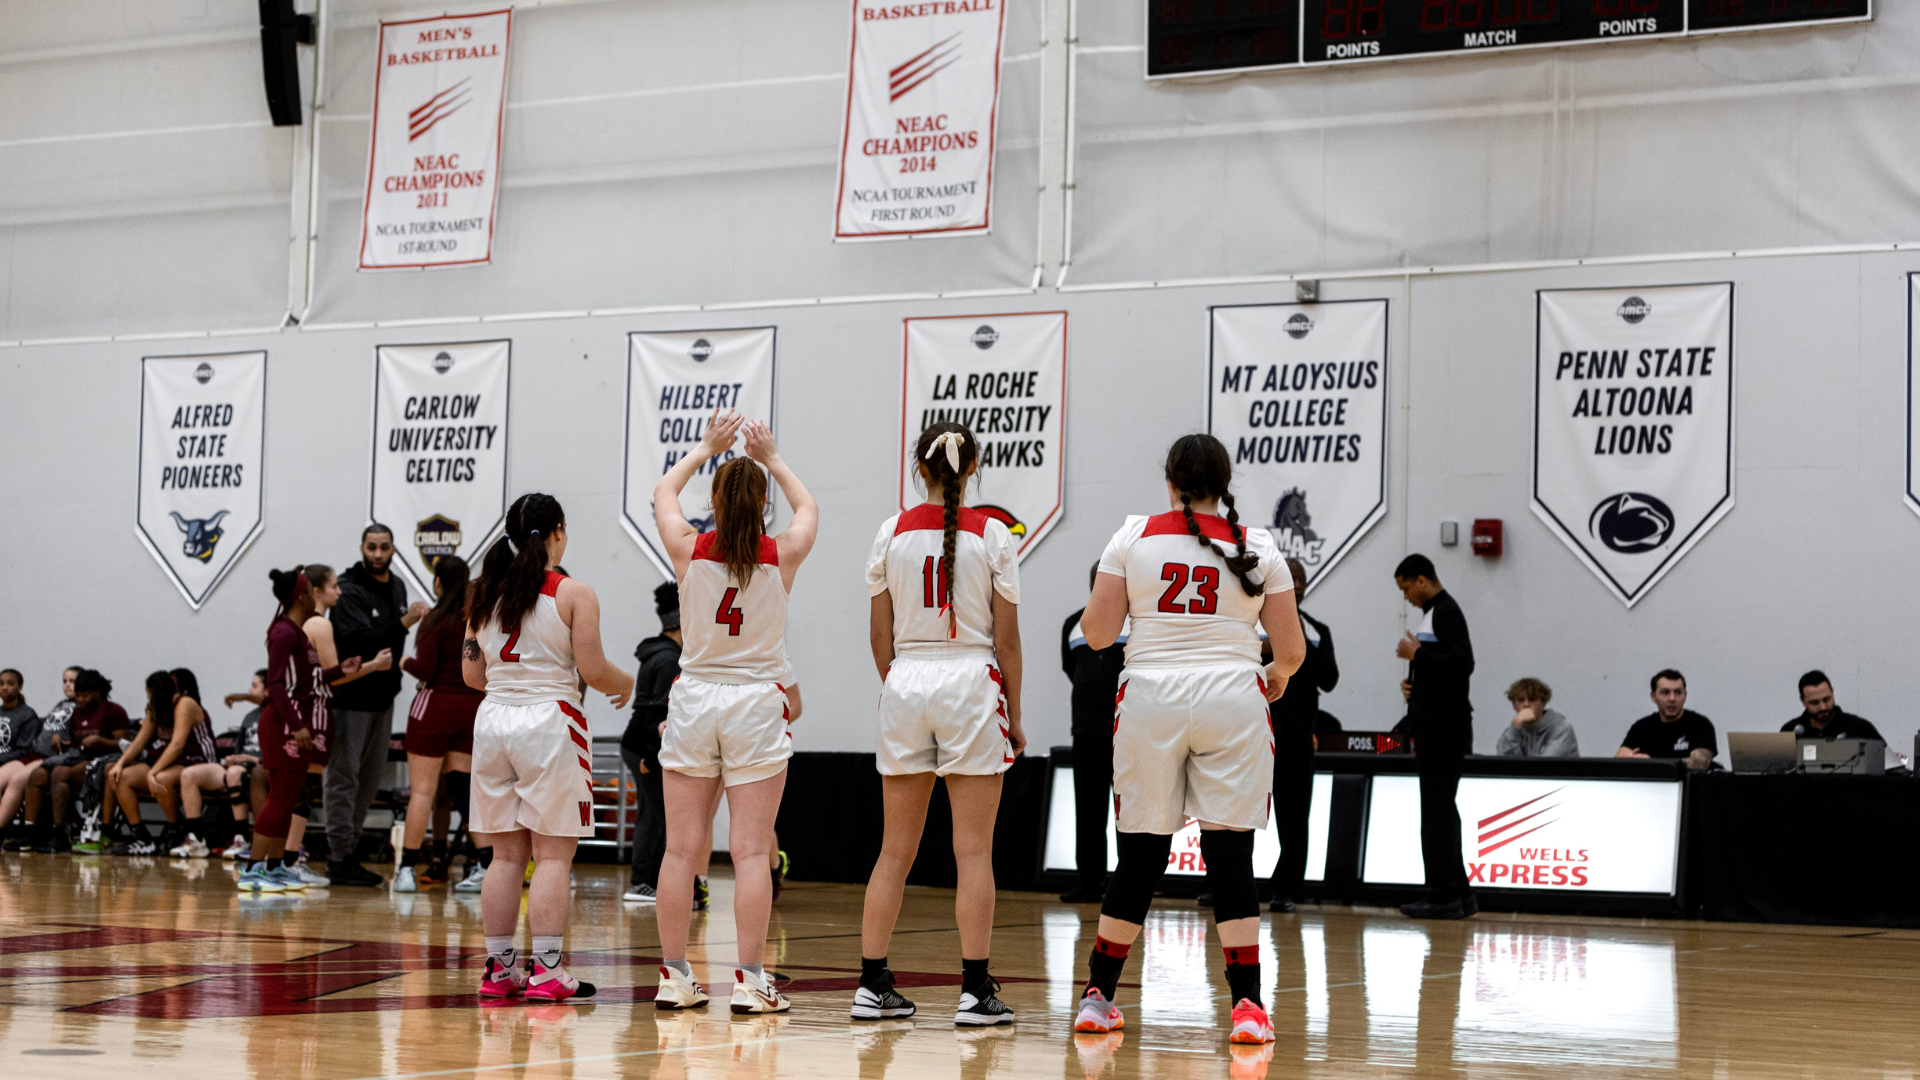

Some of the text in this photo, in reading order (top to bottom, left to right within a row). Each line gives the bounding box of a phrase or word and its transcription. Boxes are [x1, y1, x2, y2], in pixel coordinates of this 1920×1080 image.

[863, 0, 995, 21] BASKETBALL
[418, 27, 472, 43] MEN'S
[1464, 30, 1517, 47] MATCH
[1599, 18, 1657, 35] POINTS
[387, 44, 500, 66] BASKETBALL
[1326, 41, 1380, 58] POINTS
[895, 114, 948, 134] NEAC
[862, 131, 979, 156] CHAMPIONS
[413, 154, 460, 172] NEAC
[899, 155, 937, 173] 2014
[384, 170, 485, 193] CHAMPIONS
[852, 181, 978, 203] NCAA TOURNAMENT
[416, 192, 448, 208] 2011
[870, 204, 955, 221] FIRST ROUND
[375, 217, 484, 237] NCAA TOURNAMENT
[1556, 346, 1716, 381] PENN STATE
[932, 371, 1039, 401] LA ROCHE
[1221, 361, 1379, 393] MT ALOYSIUS
[404, 394, 481, 421] CARLOW
[660, 383, 742, 410] HILBERT
[1572, 386, 1694, 418] ALTOONA
[171, 403, 233, 430] ALFRED
[1249, 398, 1348, 428] COLLEGE
[389, 425, 497, 452] UNIVERSITY
[660, 416, 738, 443] COLL
[1594, 424, 1674, 455] LIONS
[177, 433, 227, 459] STATE
[1236, 434, 1361, 464] MOUNTIES
[161, 463, 243, 490] PIONEERS
[406, 457, 475, 483] CELTICS
[1268, 526, 1326, 565] MAC
[922, 555, 948, 608] 11
[1158, 562, 1219, 615] 23
[715, 587, 744, 636] 4
[501, 625, 521, 663] 2
[1348, 736, 1375, 751] POSS.
[578, 801, 591, 827] W
[1520, 847, 1589, 862] WELLS
[1467, 862, 1589, 886] XPRESS
